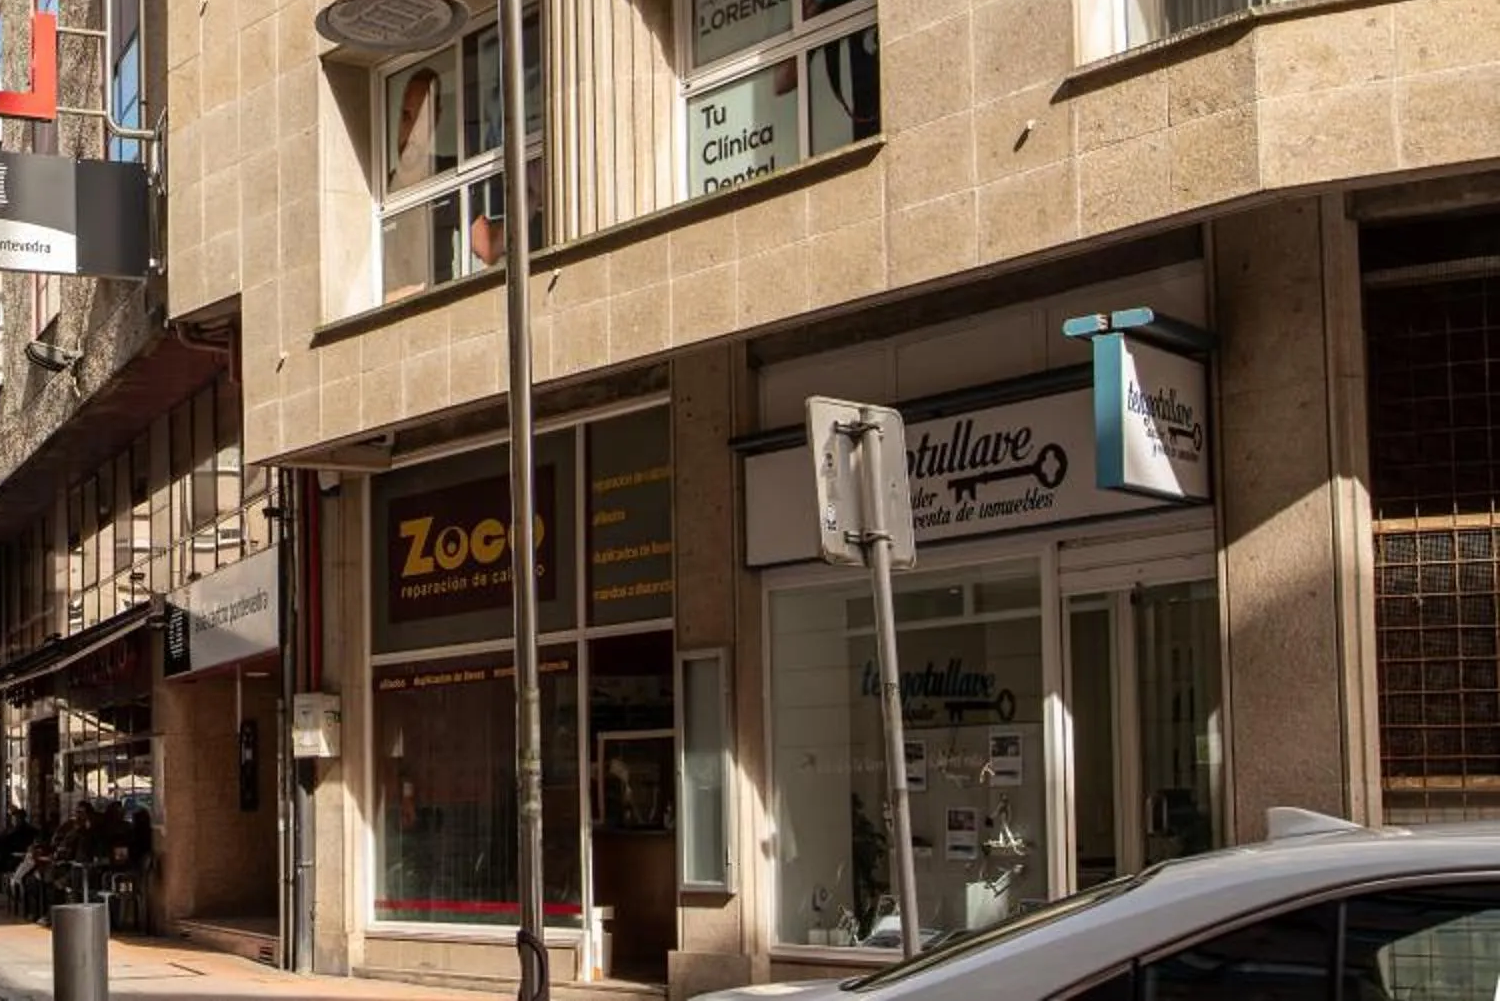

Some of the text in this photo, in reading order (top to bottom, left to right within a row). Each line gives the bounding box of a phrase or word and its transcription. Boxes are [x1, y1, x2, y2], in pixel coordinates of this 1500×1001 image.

[702, 104, 726, 131] Tu
[703, 124, 774, 165] Clínica
[956, 502, 972, 522] de
[401, 575, 467, 600] reparación
[471, 573, 487, 587] de
